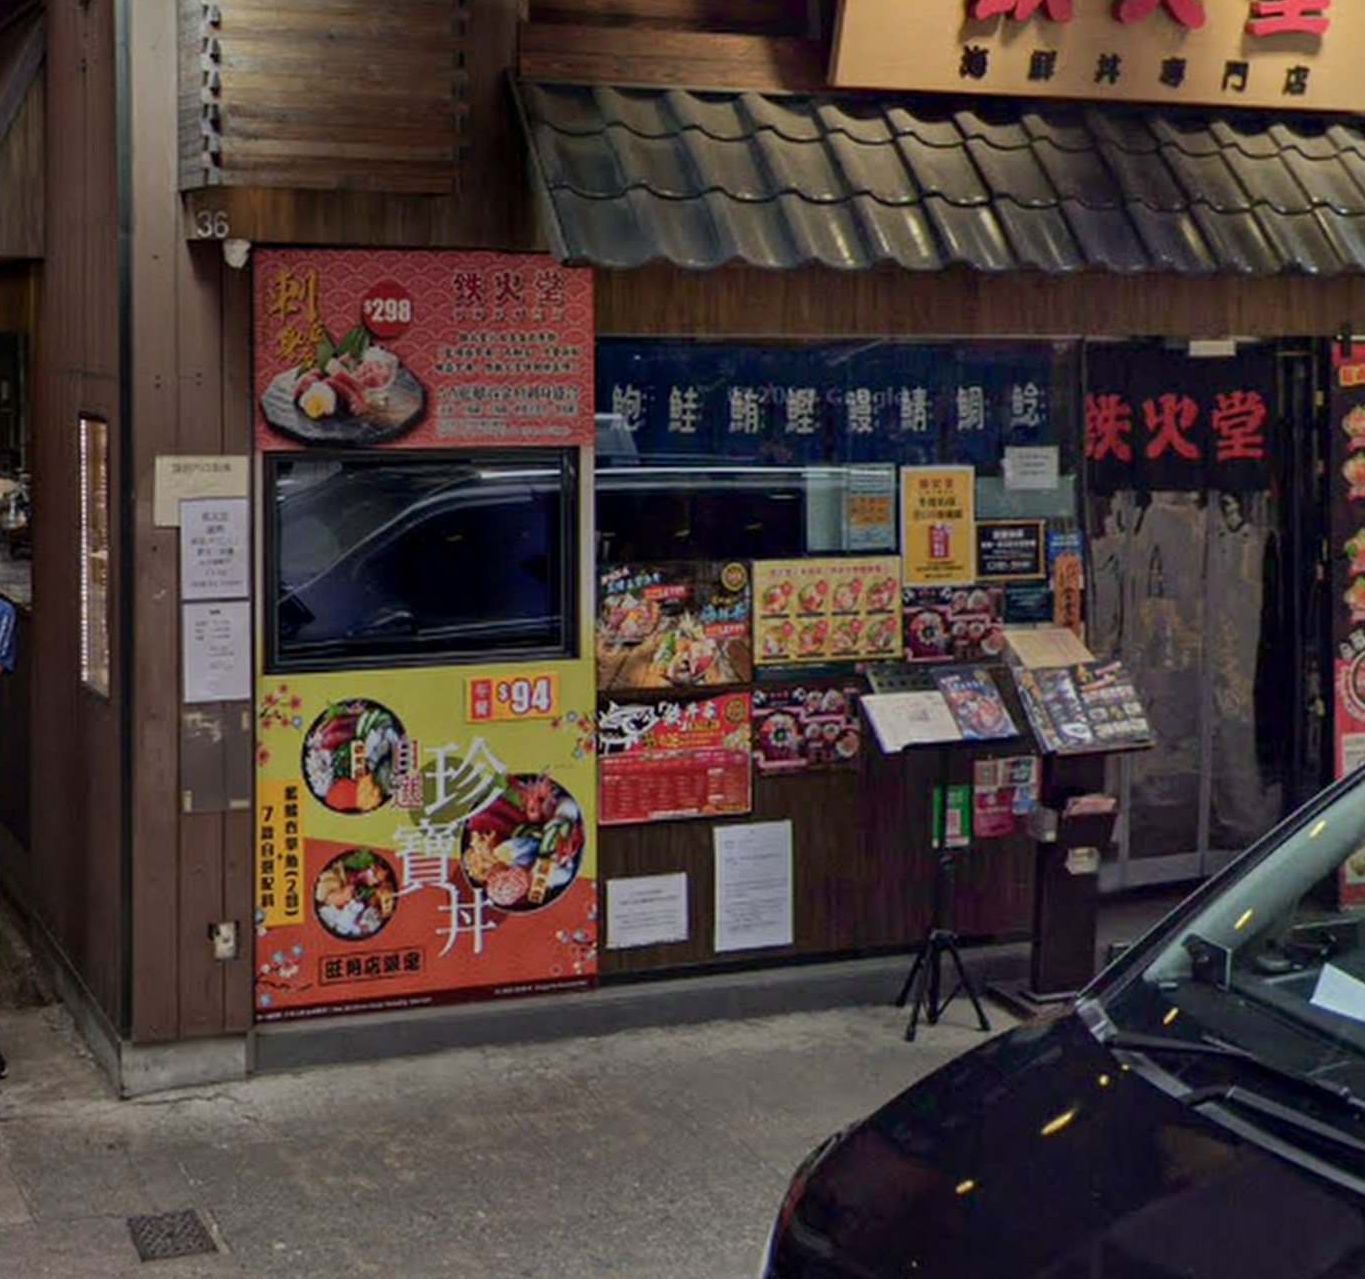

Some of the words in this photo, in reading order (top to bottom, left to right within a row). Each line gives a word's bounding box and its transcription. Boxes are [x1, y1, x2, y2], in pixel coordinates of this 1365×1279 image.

[197, 211, 229, 238] 36
[364, 299, 412, 322] $298
[497, 677, 551, 714] $94
